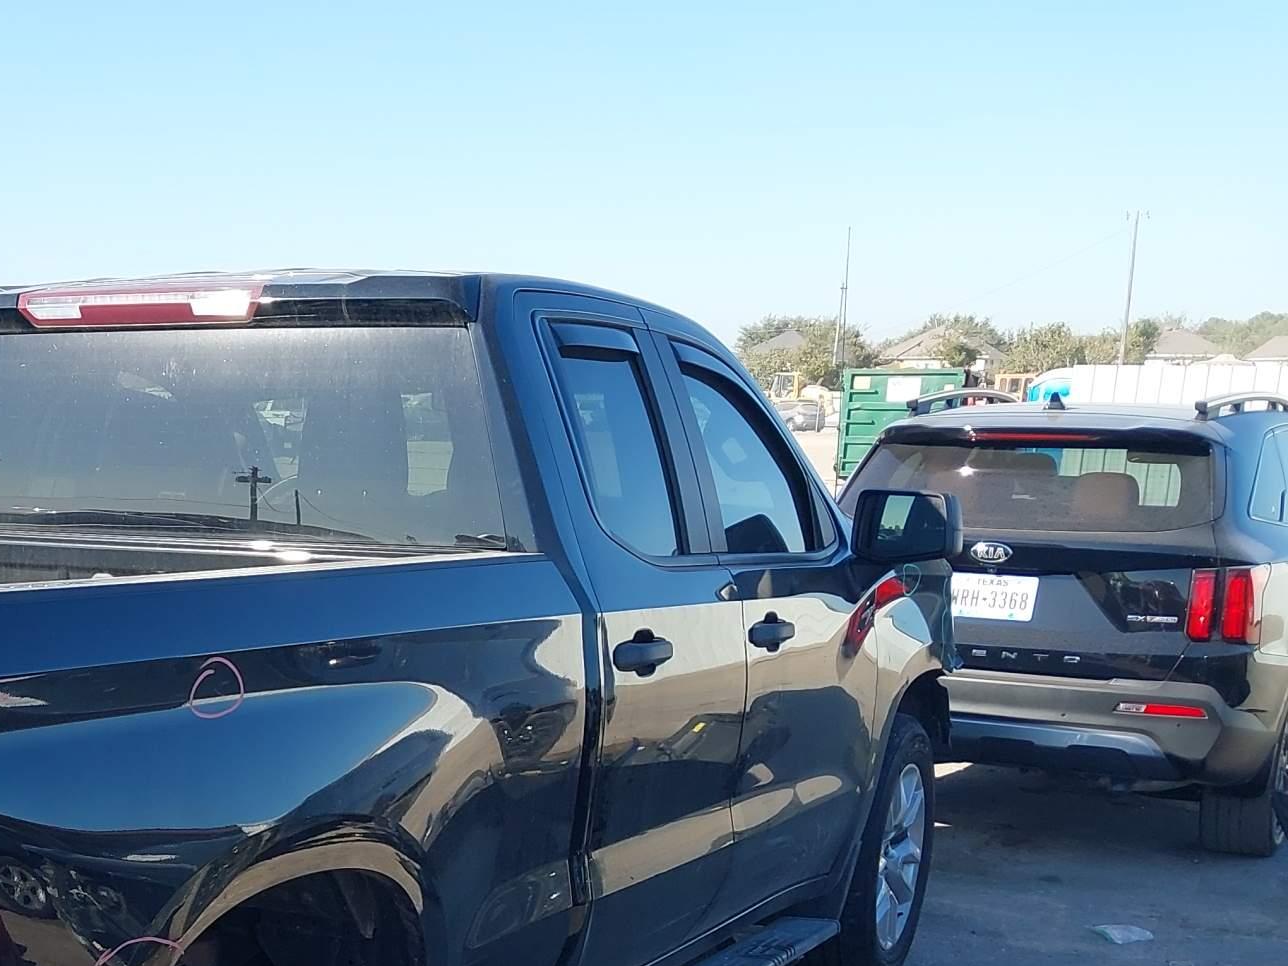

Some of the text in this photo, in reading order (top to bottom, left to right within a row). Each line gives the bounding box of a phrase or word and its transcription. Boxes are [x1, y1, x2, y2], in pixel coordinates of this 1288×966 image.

[977, 546, 1006, 559] KIA
[977, 578, 1009, 587] TEXAS
[972, 649, 1081, 663] ENTO
